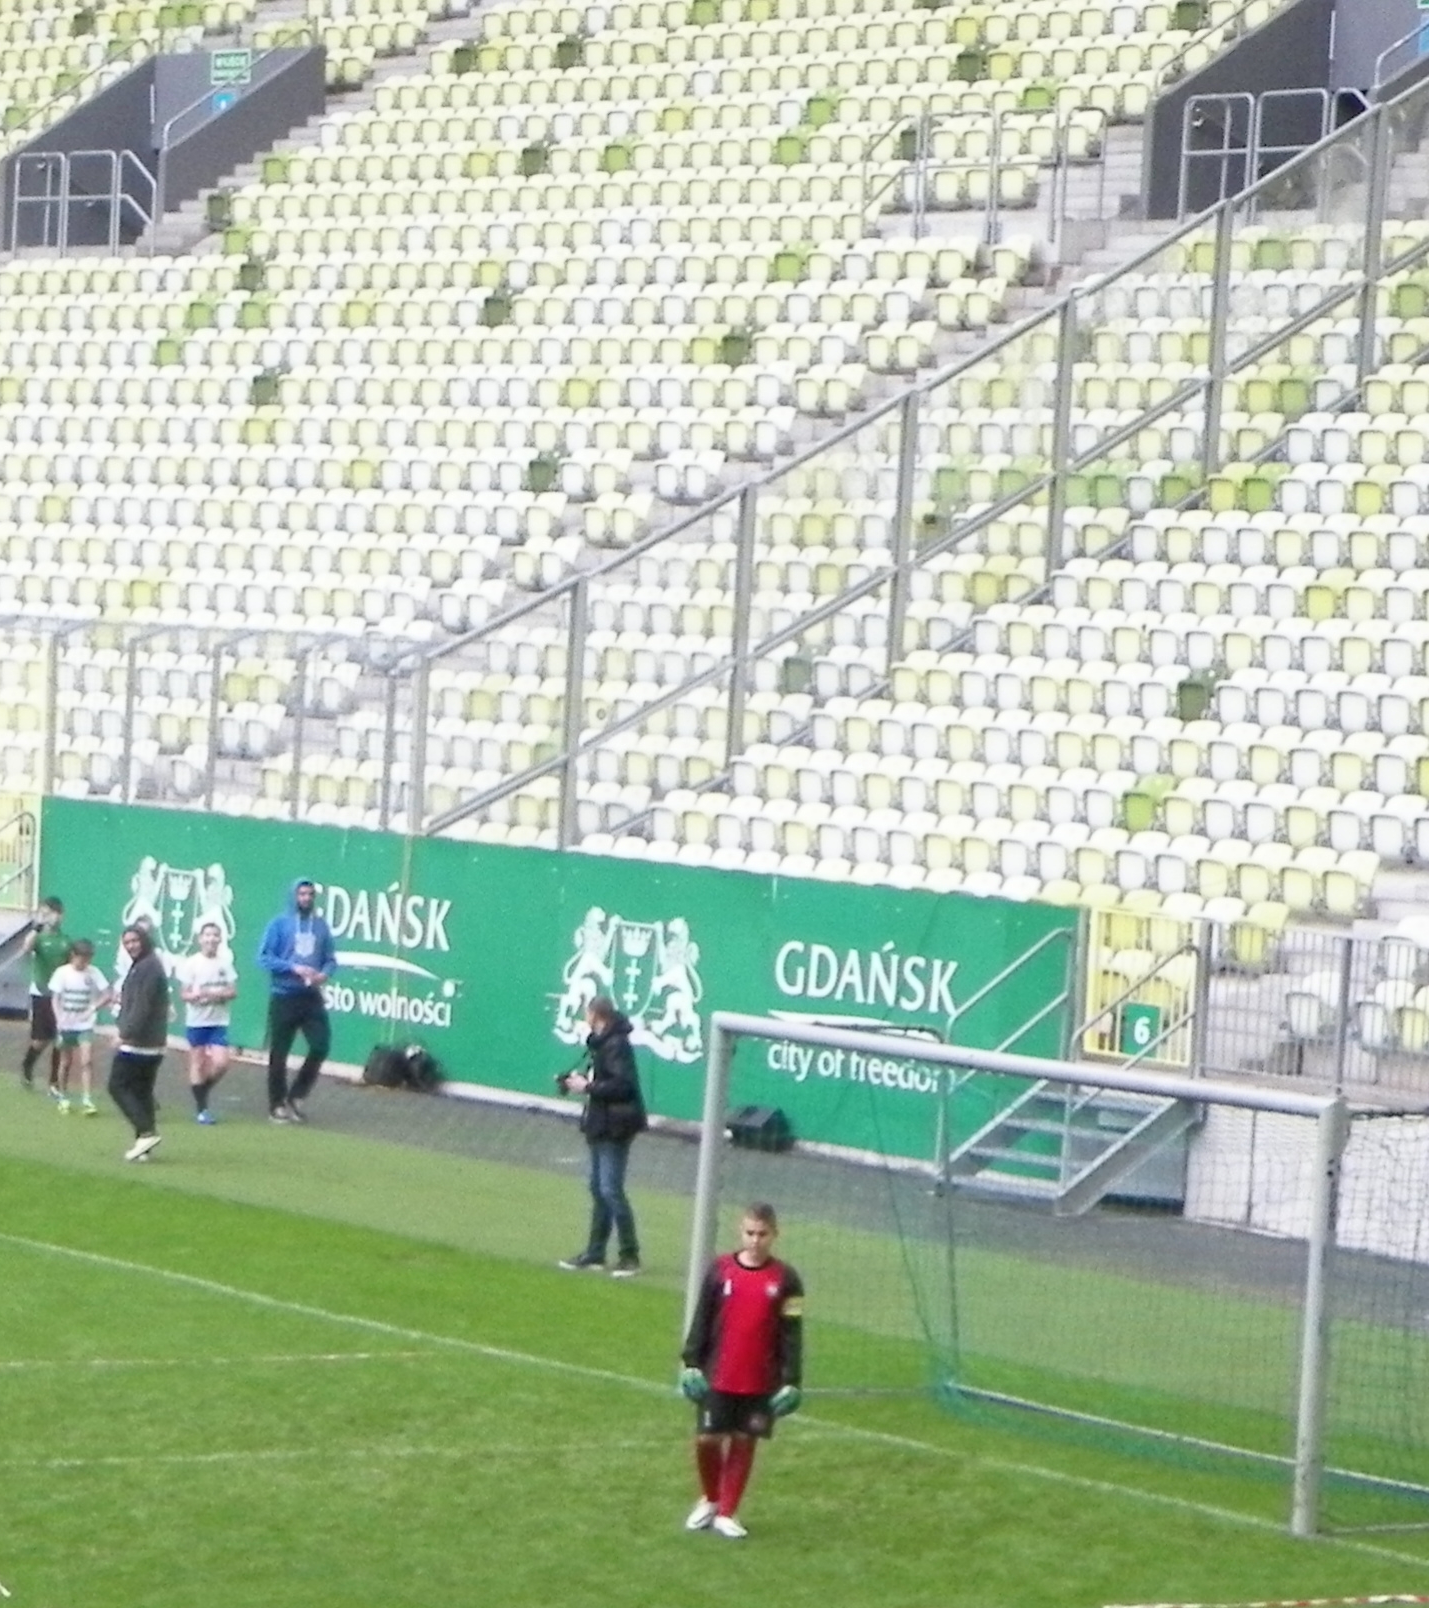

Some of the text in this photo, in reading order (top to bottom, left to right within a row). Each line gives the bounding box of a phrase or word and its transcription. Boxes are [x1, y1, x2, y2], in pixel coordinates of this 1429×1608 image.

[774, 940, 959, 1018] GDAŃSK
[359, 987, 453, 1028] wolności
[1134, 1016, 1151, 1045] 6
[767, 1040, 814, 1082] city
